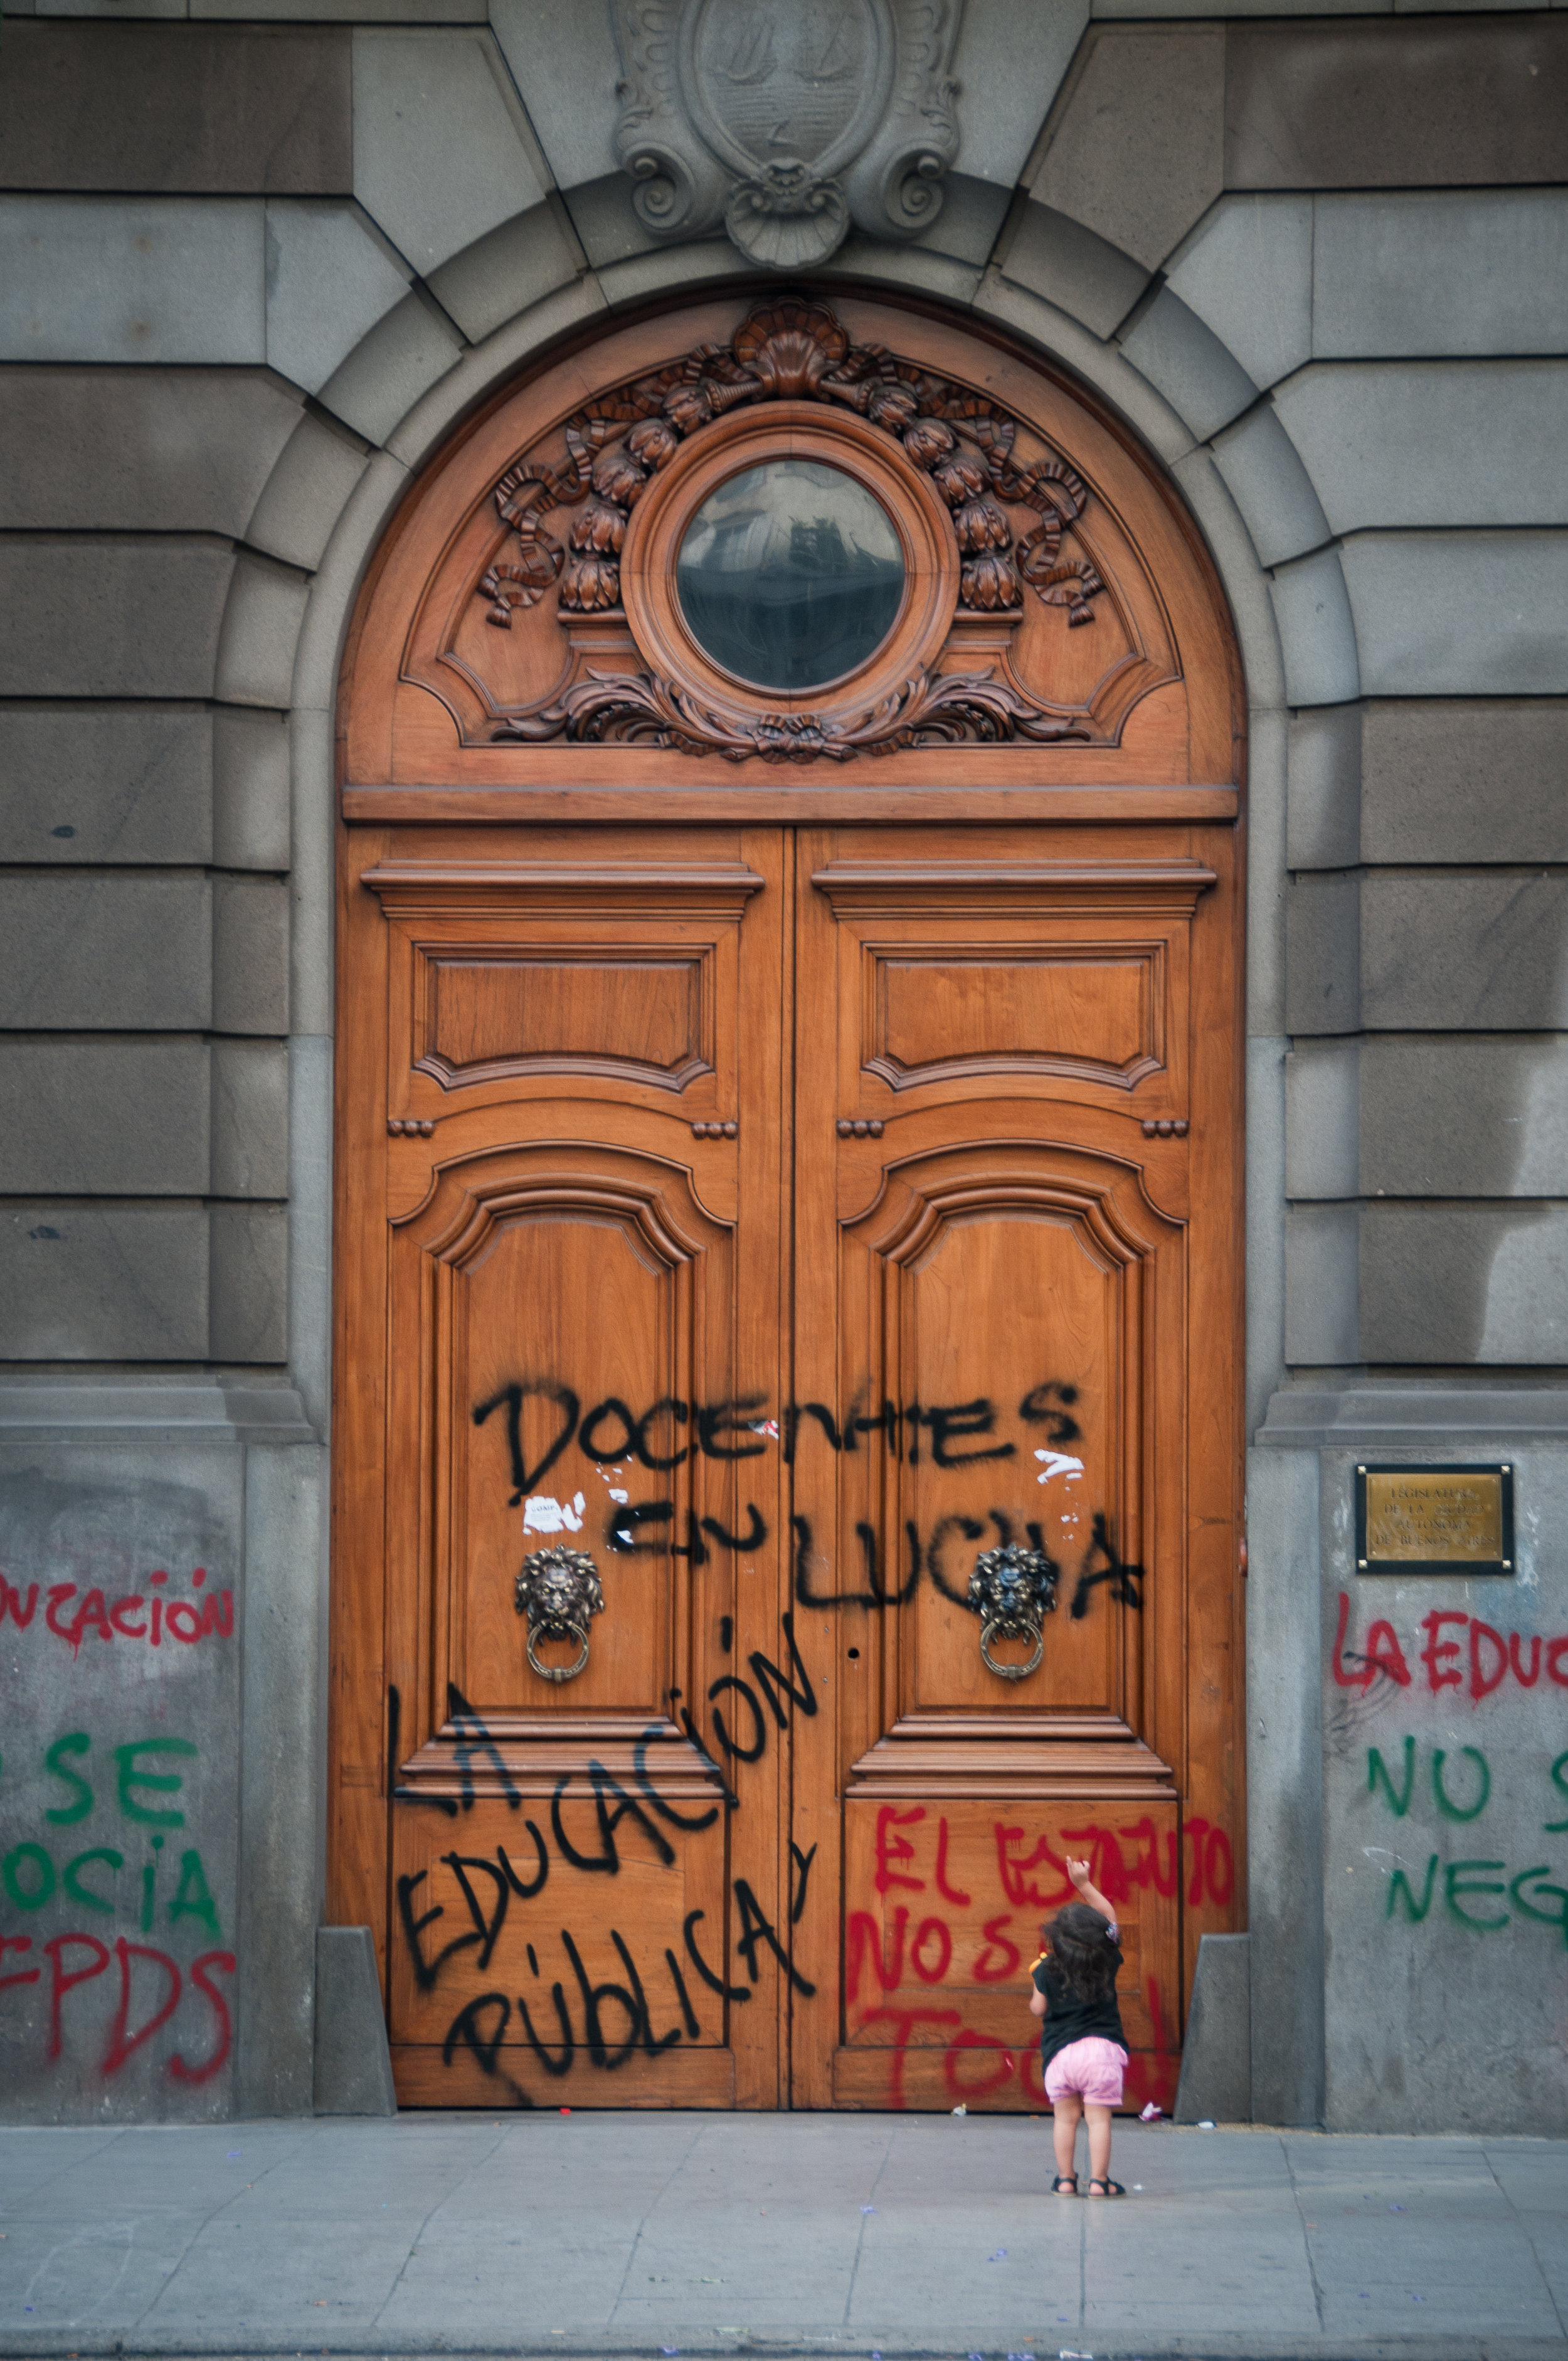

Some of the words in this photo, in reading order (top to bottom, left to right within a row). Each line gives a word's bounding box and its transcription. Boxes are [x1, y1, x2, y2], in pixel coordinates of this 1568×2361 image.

[1376, 1535, 1391, 1546] DE
[1401, 1535, 1449, 1546] BUENOS
[1458, 1535, 1495, 1546] AIRES
[1384, 1504, 1400, 1514] DE
[1409, 1504, 1424, 1514] LA
[1434, 1504, 1485, 1515] CIUDAD
[1391, 1488, 1479, 1499] LEGISLATURA
[1333, 1593, 1411, 1687] LA
[46, 1732, 197, 1828] SE
[386, 1683, 522, 1817] LA
[876, 1807, 970, 1907] EL
[847, 1907, 952, 2005] NO
